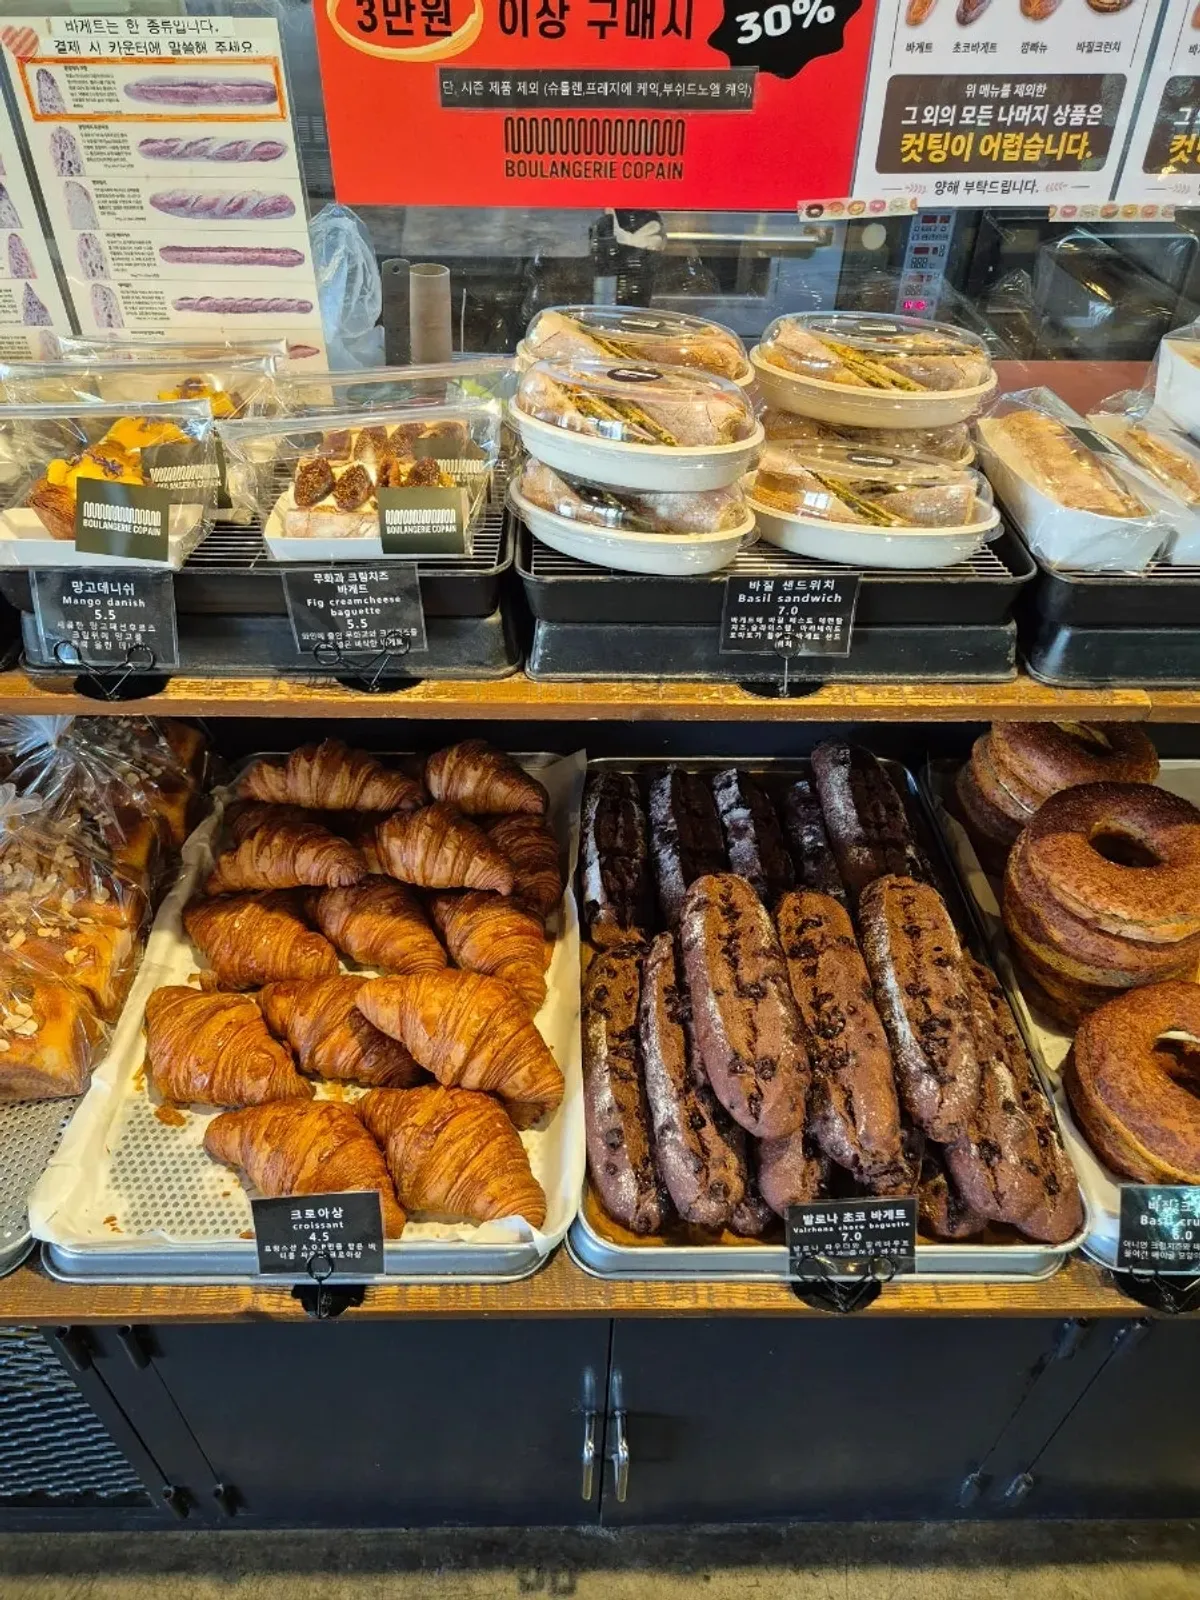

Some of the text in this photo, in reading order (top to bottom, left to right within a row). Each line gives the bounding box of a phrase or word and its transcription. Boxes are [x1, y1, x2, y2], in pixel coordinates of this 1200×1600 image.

[357, 0, 453, 36] 3만원
[499, 0, 570, 39] 이상
[735, 0, 836, 45] 30%
[65, 18, 219, 35] 바게트는 한 종류입니다.
[54, 40, 259, 55] 결제 시 카운터에 말씀해 주세요.
[905, 42, 933, 54] 바게트
[952, 42, 998, 54] 초코바게트
[1076, 41, 1121, 54] 바질크런치
[442, 80, 458, 97] 단,
[461, 80, 484, 96] 시즌
[489, 80, 512, 96] 제품
[517, 80, 539, 97] 제외
[965, 84, 1047, 98] 위 메뉴를 제외한
[901, 104, 1103, 127] 그 외의 모든 나머지 상품은
[901, 131, 1092, 163] 컷팅이 어렵습니다.
[505, 159, 684, 180] BOULANGERIE COPAIN
[934, 180, 1039, 195] 양해 부탁드립니다.
[83, 519, 161, 536] BOULANGERIE COPAIN
[387, 525, 457, 534] BOULANGERIE COPAIN
[313, 571, 389, 584] 무화과 크림치즈
[71, 581, 135, 596] 망고데니쉬
[337, 584, 369, 595] 바게트
[749, 579, 836, 592] 바질 샌드위치
[62, 596, 146, 608] Mango danish
[306, 596, 401, 609] Fig creamcheese
[738, 593, 842, 603] Basil sandwich
[95, 610, 116, 620] 5.5
[330, 607, 381, 618] baguette
[778, 606, 799, 616] 7.0
[347, 618, 368, 629] 5.5
[291, 1207, 344, 1220] 크로아상
[803, 1209, 906, 1226] 발로나 초코 바게트
[292, 1221, 344, 1230] croissant
[309, 1232, 330, 1242] 4.5
[842, 1232, 862, 1241] 7.0
[1172, 1229, 1193, 1240] 6.0
